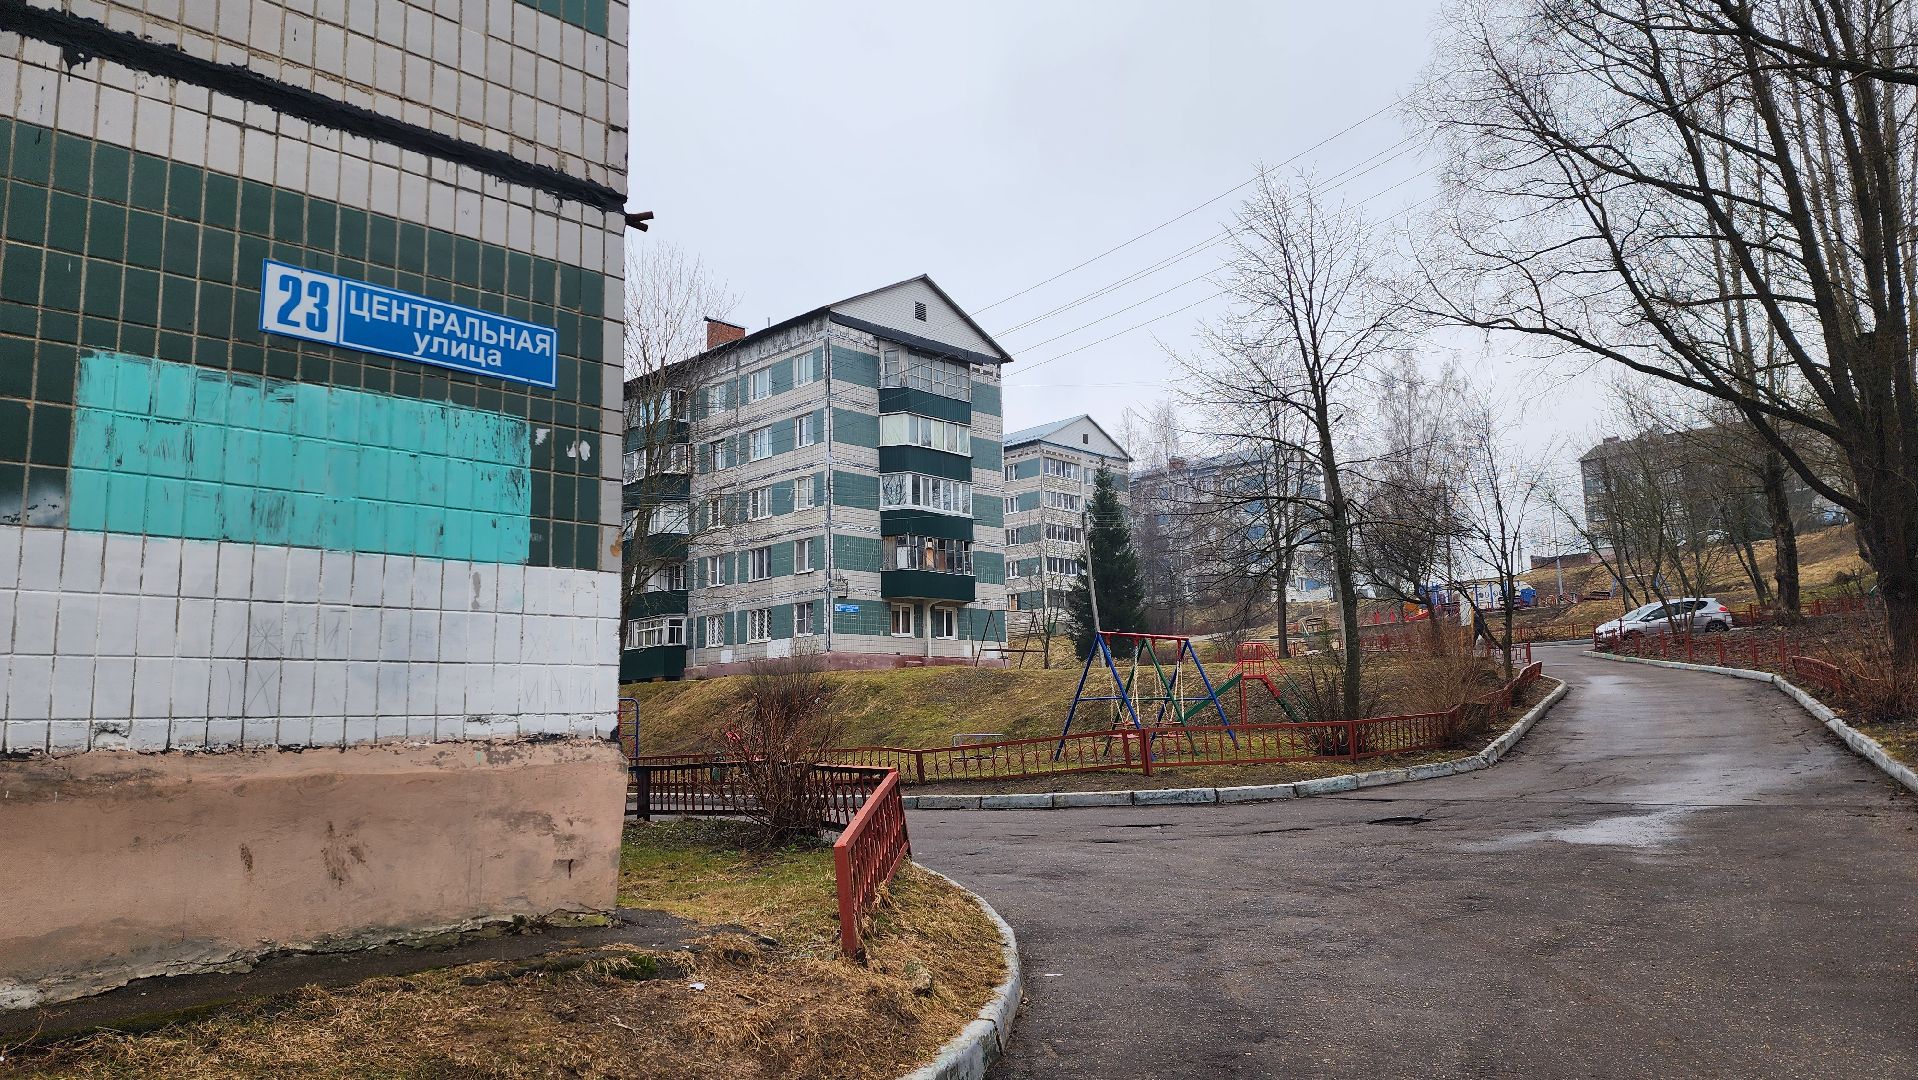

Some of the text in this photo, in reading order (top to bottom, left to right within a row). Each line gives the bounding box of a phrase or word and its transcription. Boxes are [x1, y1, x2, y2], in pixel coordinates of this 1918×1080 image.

[277, 274, 329, 333] 23
[350, 292, 551, 357] ЦЕНТРАЛЬНАЯ
[413, 332, 502, 367] улица
